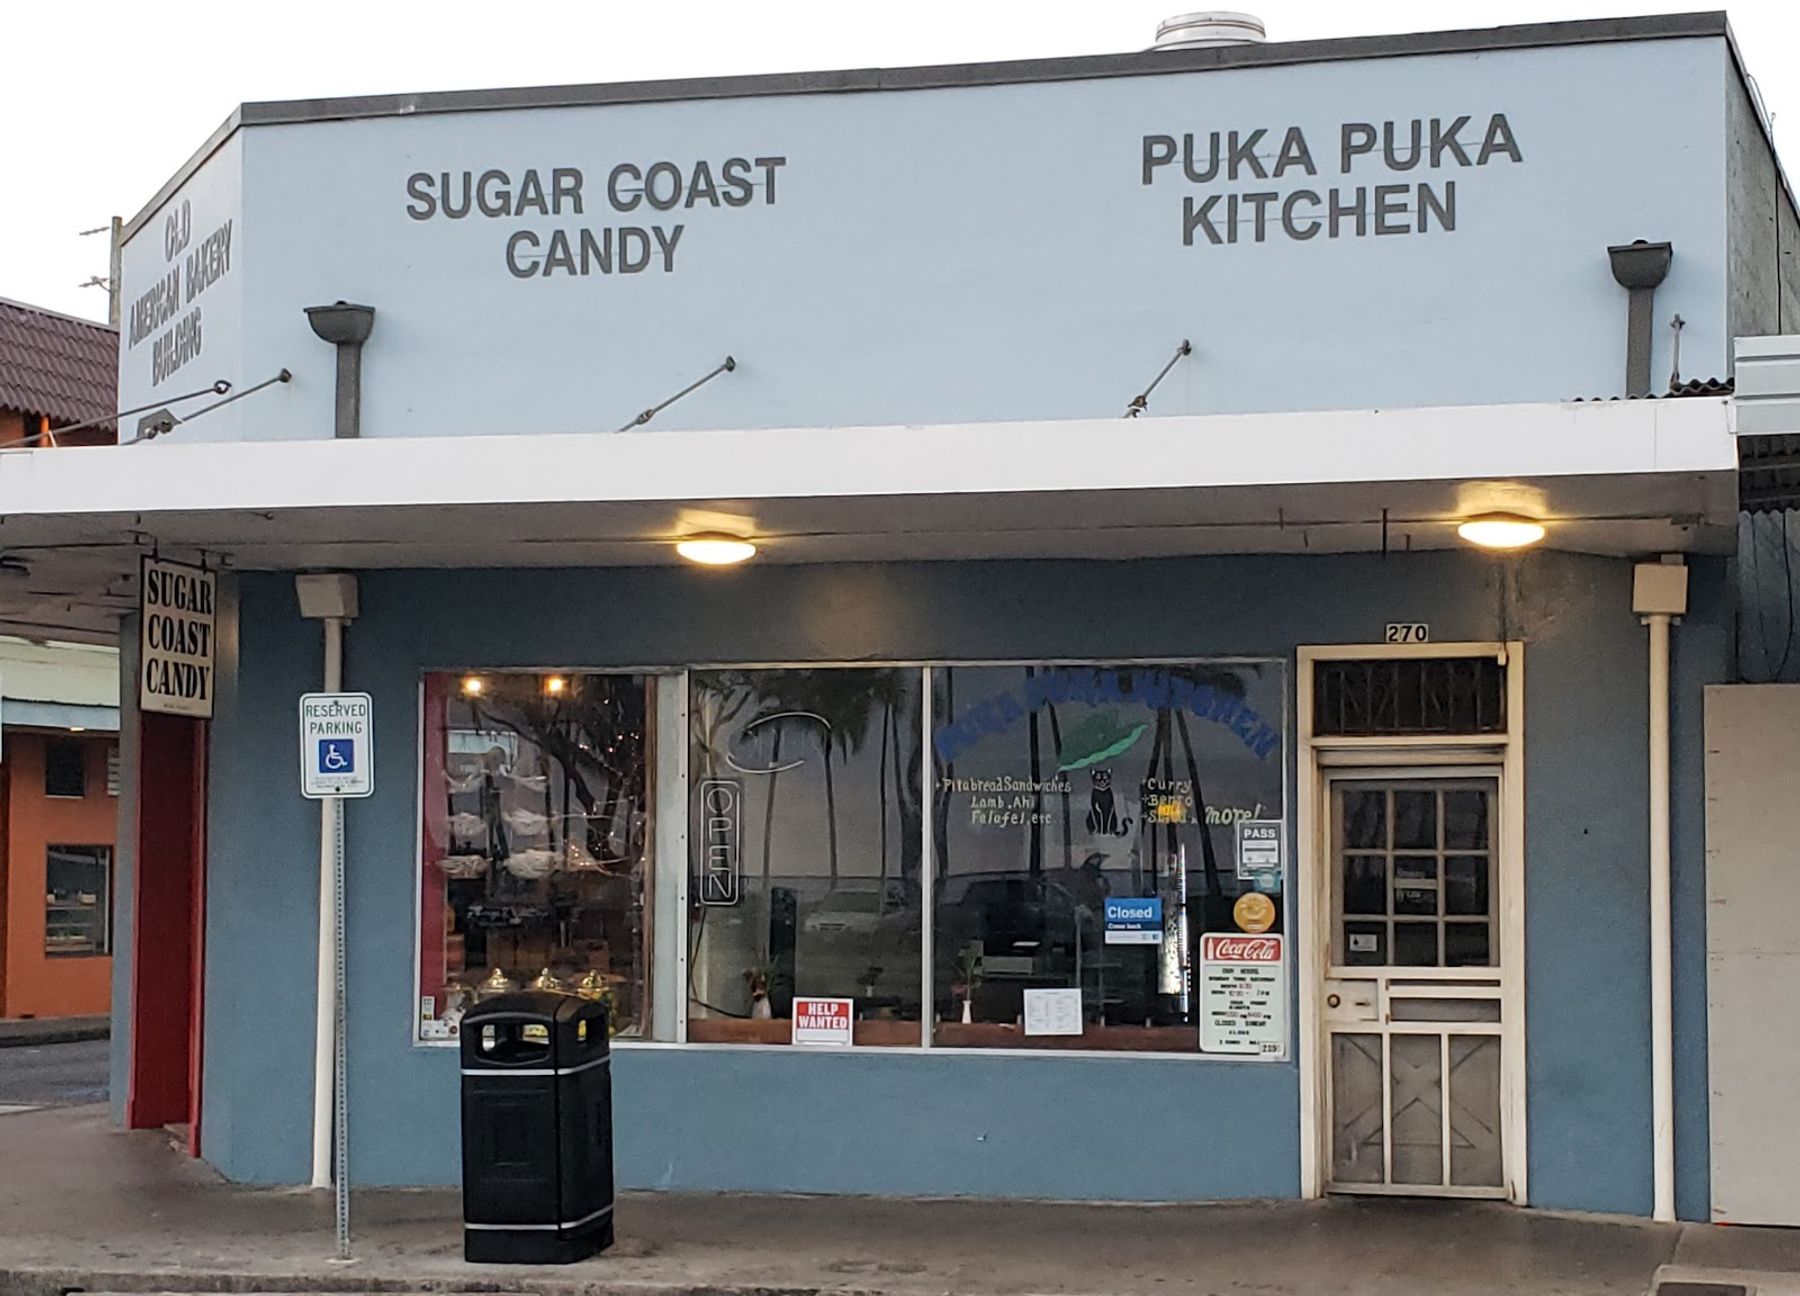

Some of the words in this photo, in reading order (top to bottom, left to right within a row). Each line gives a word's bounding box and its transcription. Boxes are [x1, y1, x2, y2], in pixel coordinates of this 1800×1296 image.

[1141, 126, 1317, 185] PUKA
[1340, 113, 1523, 174] PUKA
[406, 168, 584, 221] SUGAR
[607, 156, 787, 213] COAST
[165, 199, 191, 262] OLD
[1182, 181, 1456, 247] KITCHEN
[506, 224, 685, 278] CANDY
[128, 264, 180, 350] AMERICAN
[186, 218, 232, 304] BAKERY
[152, 306, 201, 387] BUILDING
[148, 569, 212, 615] SUGAR
[148, 614, 210, 657] COAST
[1388, 625, 1427, 641] 270
[146, 658, 210, 700] CANDY
[306, 704, 366, 718] RESERVED
[310, 721, 362, 735] PARKING
[1148, 778, 1192, 794] Curry
[1206, 803, 1261, 825] more!
[1244, 829, 1276, 839] PASS
[706, 787, 732, 898] OPEN
[1108, 906, 1153, 918] Closed
[799, 1015, 847, 1029] WANTED
[808, 1003, 838, 1015] HELP
